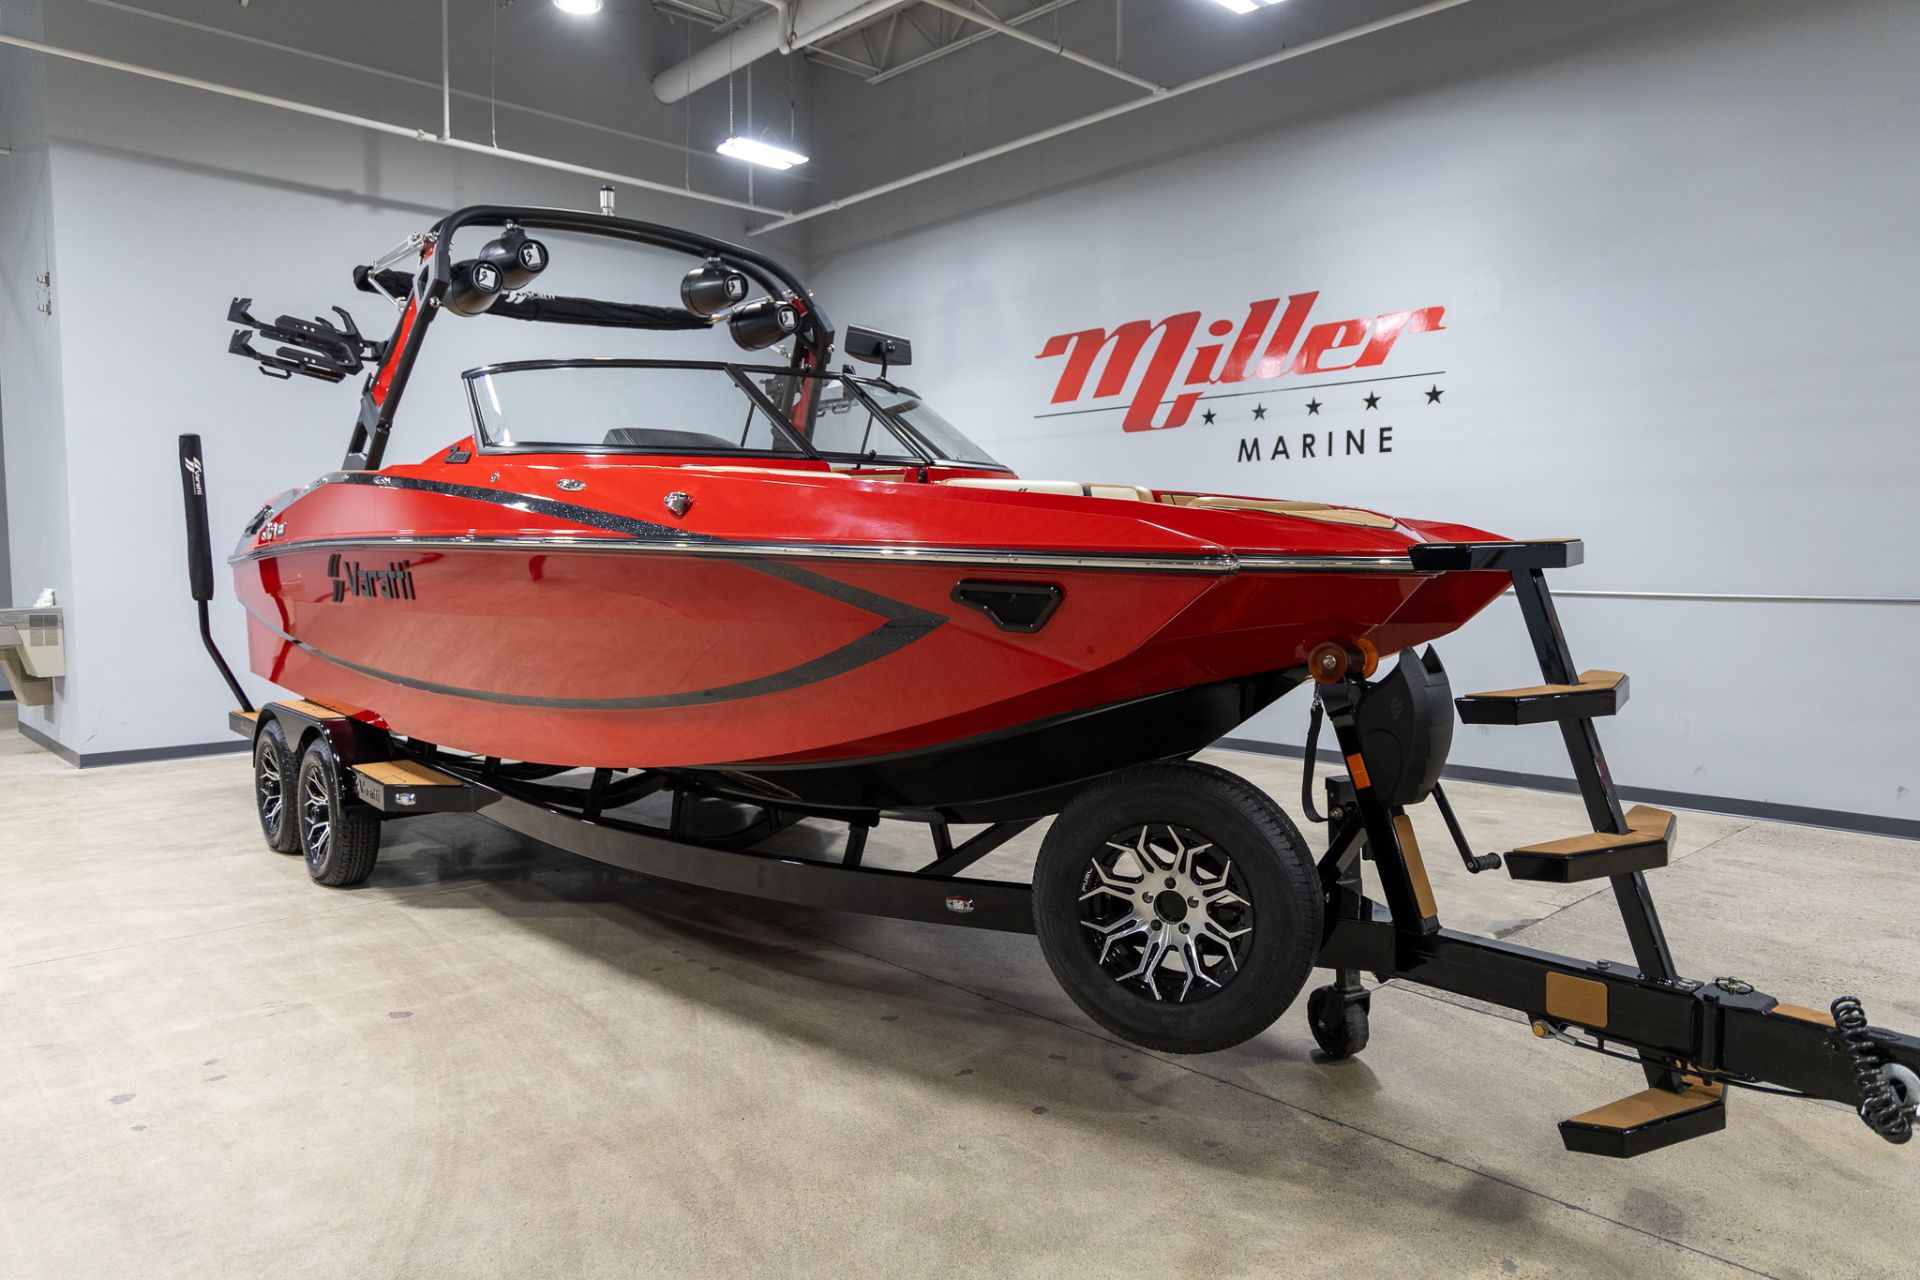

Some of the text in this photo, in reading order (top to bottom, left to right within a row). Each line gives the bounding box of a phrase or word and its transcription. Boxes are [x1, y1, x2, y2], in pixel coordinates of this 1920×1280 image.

[1034, 290, 1446, 433] Miller
[1237, 426, 1393, 462] MARINE
[343, 559, 416, 600] Varatti
[1081, 867, 1093, 892] FUEL
